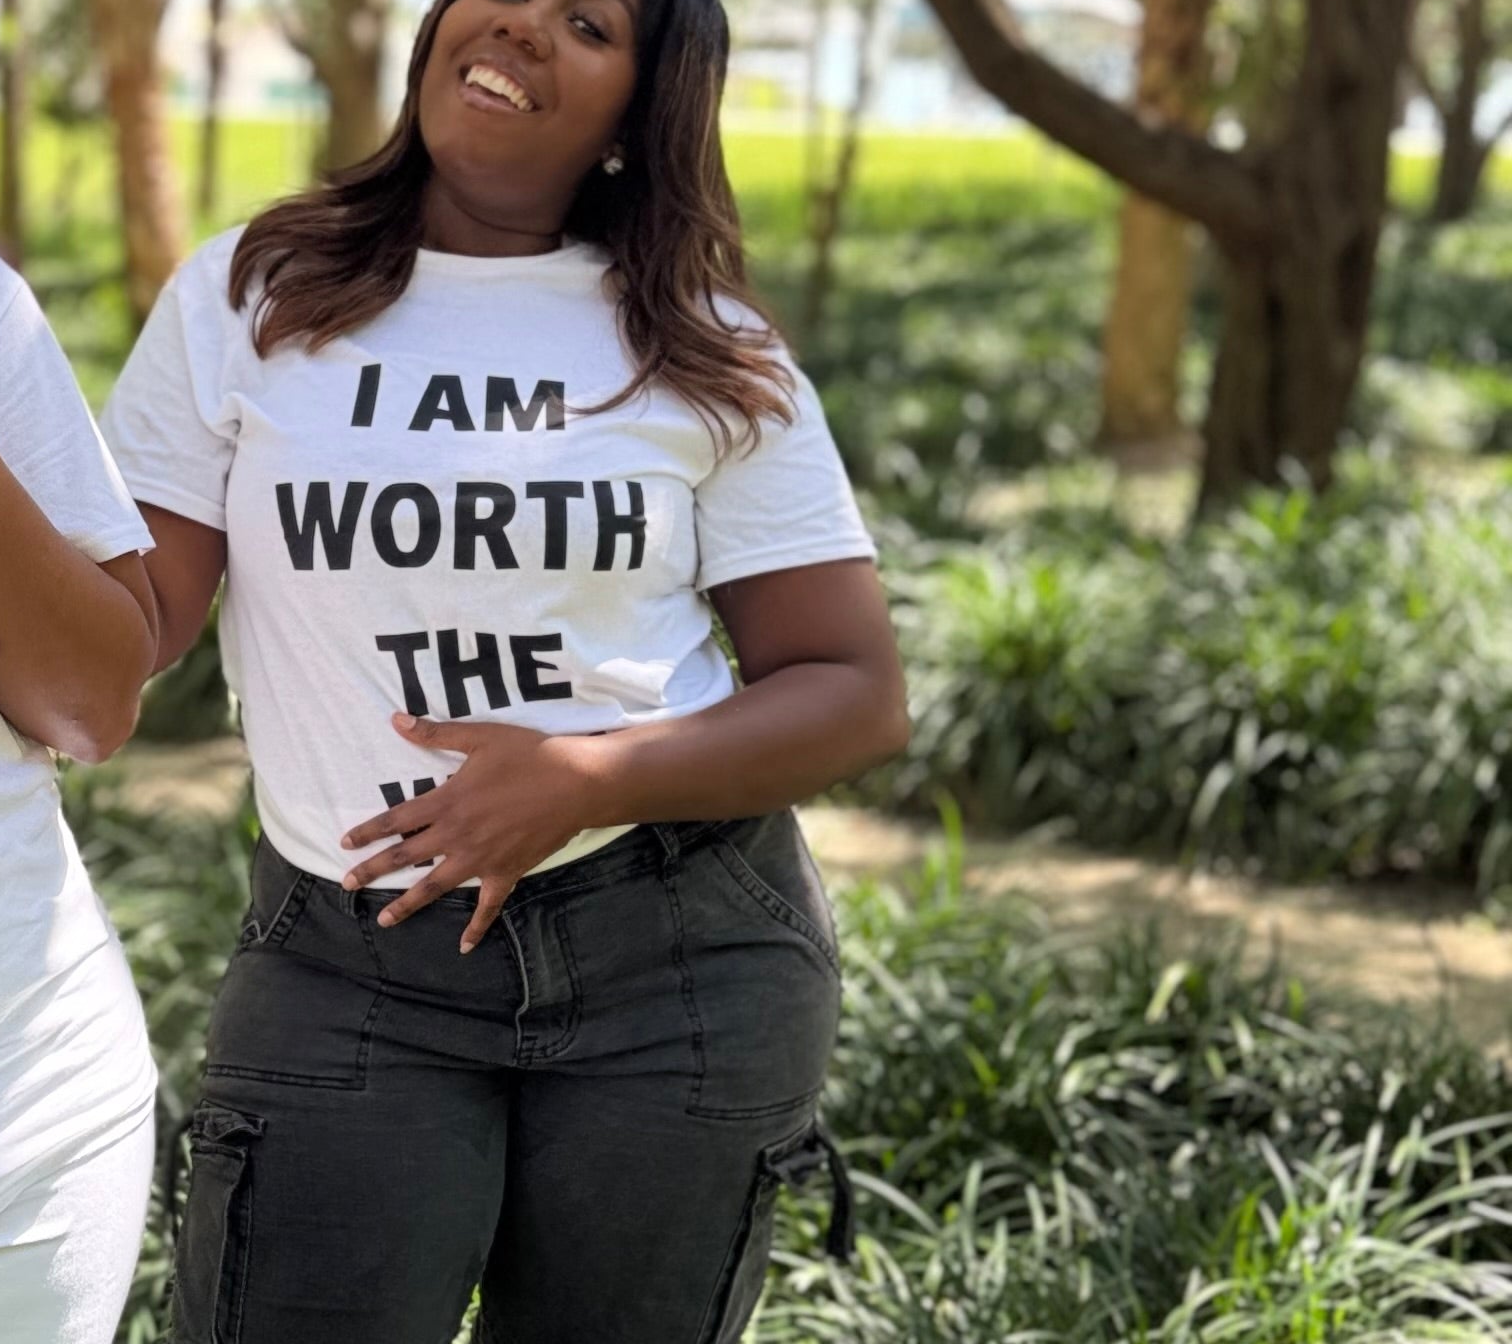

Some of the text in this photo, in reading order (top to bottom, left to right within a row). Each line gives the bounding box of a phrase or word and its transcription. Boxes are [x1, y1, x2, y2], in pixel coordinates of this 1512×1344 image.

[351, 363, 566, 431] I AM
[275, 481, 647, 571] WORTH
[376, 629, 573, 718] THE
